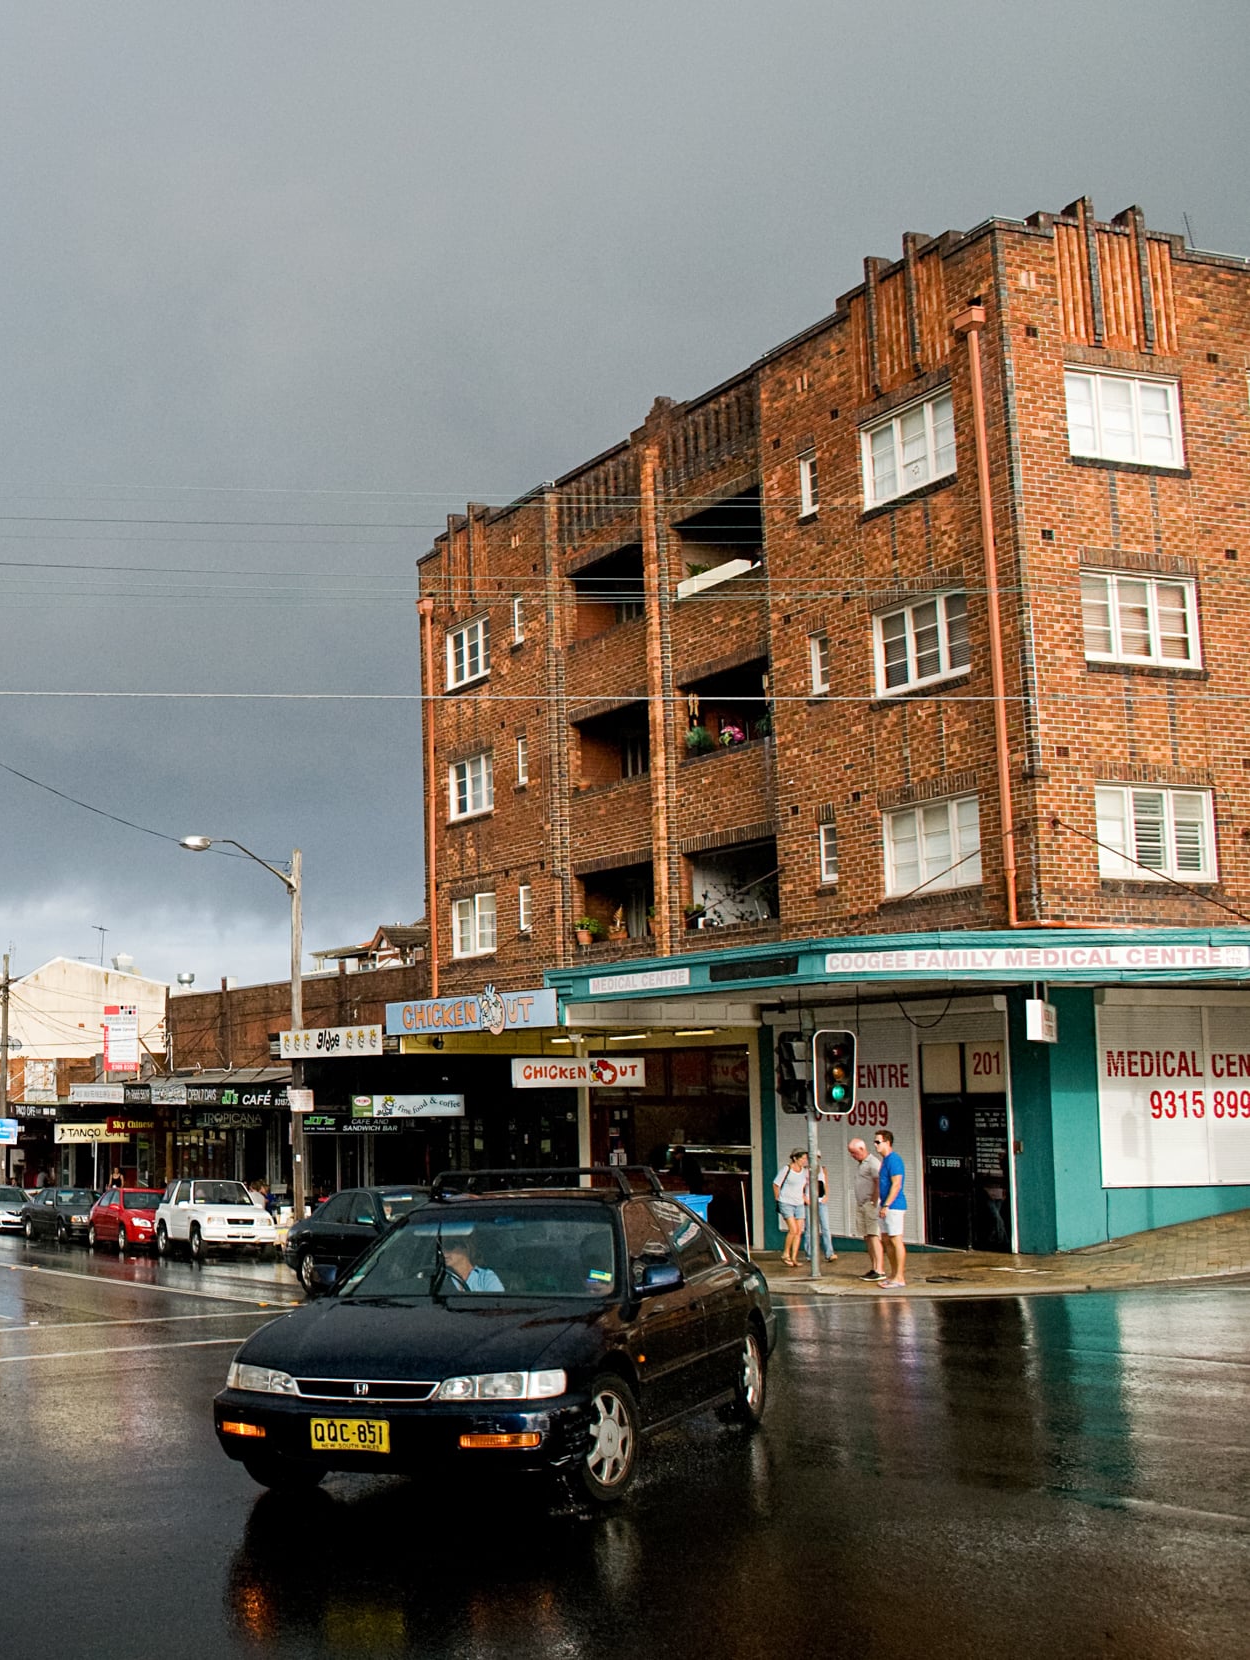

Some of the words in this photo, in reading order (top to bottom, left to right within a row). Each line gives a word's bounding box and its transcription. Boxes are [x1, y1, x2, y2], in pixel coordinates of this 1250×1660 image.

[829, 951, 908, 971] COOGEE
[914, 948, 999, 968] FAMILY
[1005, 947, 1122, 968] MEDICAL
[1126, 946, 1221, 965] CENTRE
[592, 975, 638, 994] MEDICAL
[641, 970, 686, 989] CENTRE
[402, 1000, 477, 1030] CHICKEN
[523, 1064, 587, 1080] CHICKEN
[973, 1051, 1001, 1075] 201
[1106, 1050, 1203, 1077] MEDICAL
[857, 1062, 910, 1089] ENTRE
[242, 1089, 272, 1106] CAFÉ
[412, 1098, 428, 1114] food
[430, 1096, 438, 1105] &
[439, 1099, 461, 1109] coffee
[1150, 1090, 1205, 1119] 9315
[113, 1120, 125, 1129] Sky
[203, 1112, 262, 1124] TROPICANA
[848, 1100, 889, 1126] 8999
[67, 1128, 100, 1139] TANGO
[931, 1158, 945, 1168] 9315
[946, 1159, 961, 1169] 8999
